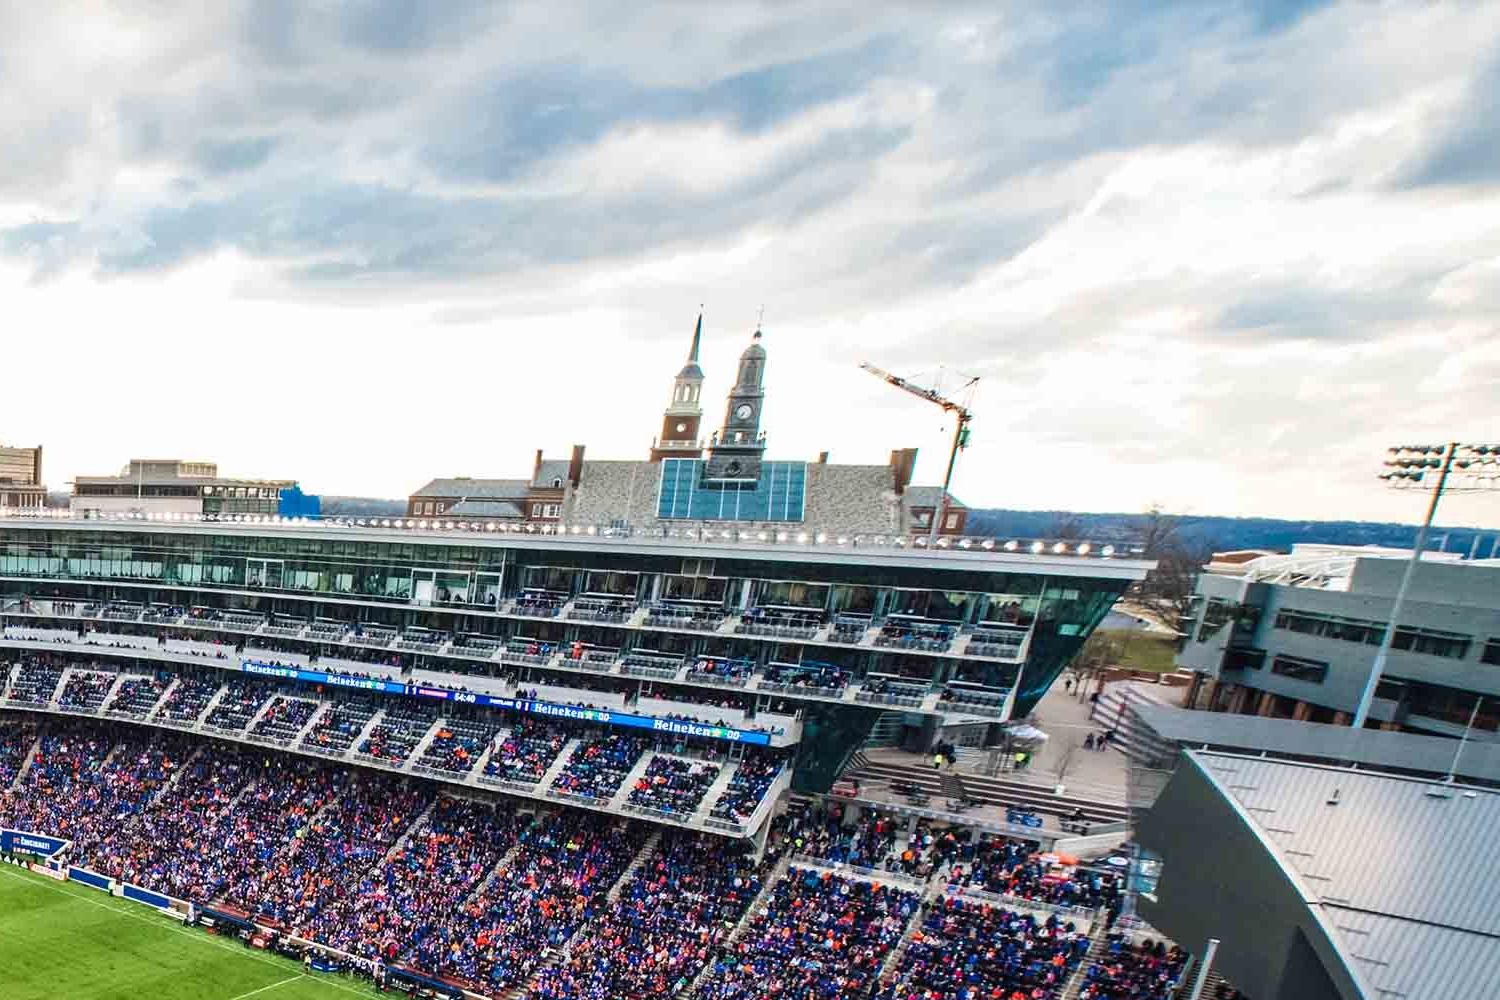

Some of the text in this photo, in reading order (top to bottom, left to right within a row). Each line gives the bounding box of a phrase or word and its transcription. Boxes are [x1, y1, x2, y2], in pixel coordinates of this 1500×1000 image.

[454, 693, 476, 703] 54:40
[534, 703, 584, 719] Heineken
[653, 719, 711, 737] Heineken
